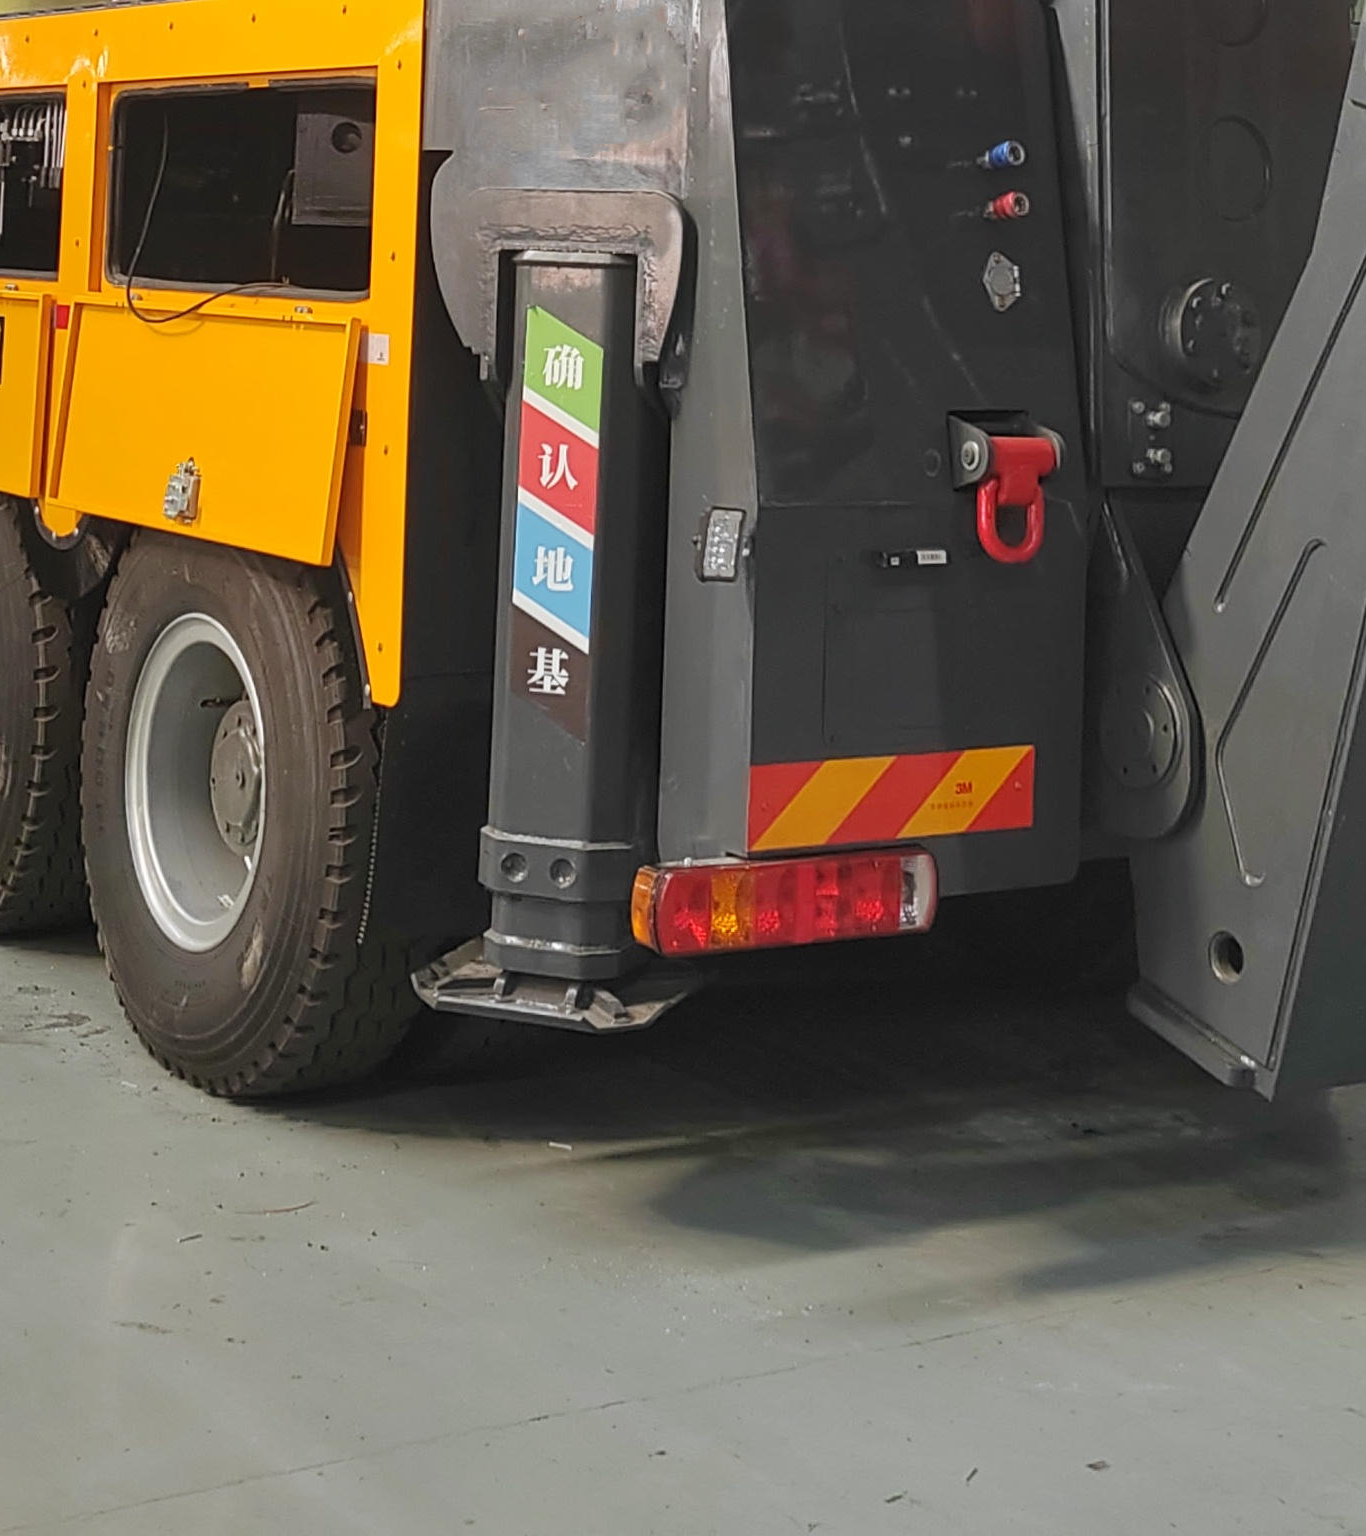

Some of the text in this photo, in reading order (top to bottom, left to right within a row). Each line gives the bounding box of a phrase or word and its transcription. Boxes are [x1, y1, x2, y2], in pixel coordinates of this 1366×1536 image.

[527, 343, 585, 696] 确认地基
[955, 781, 973, 795] 3M
